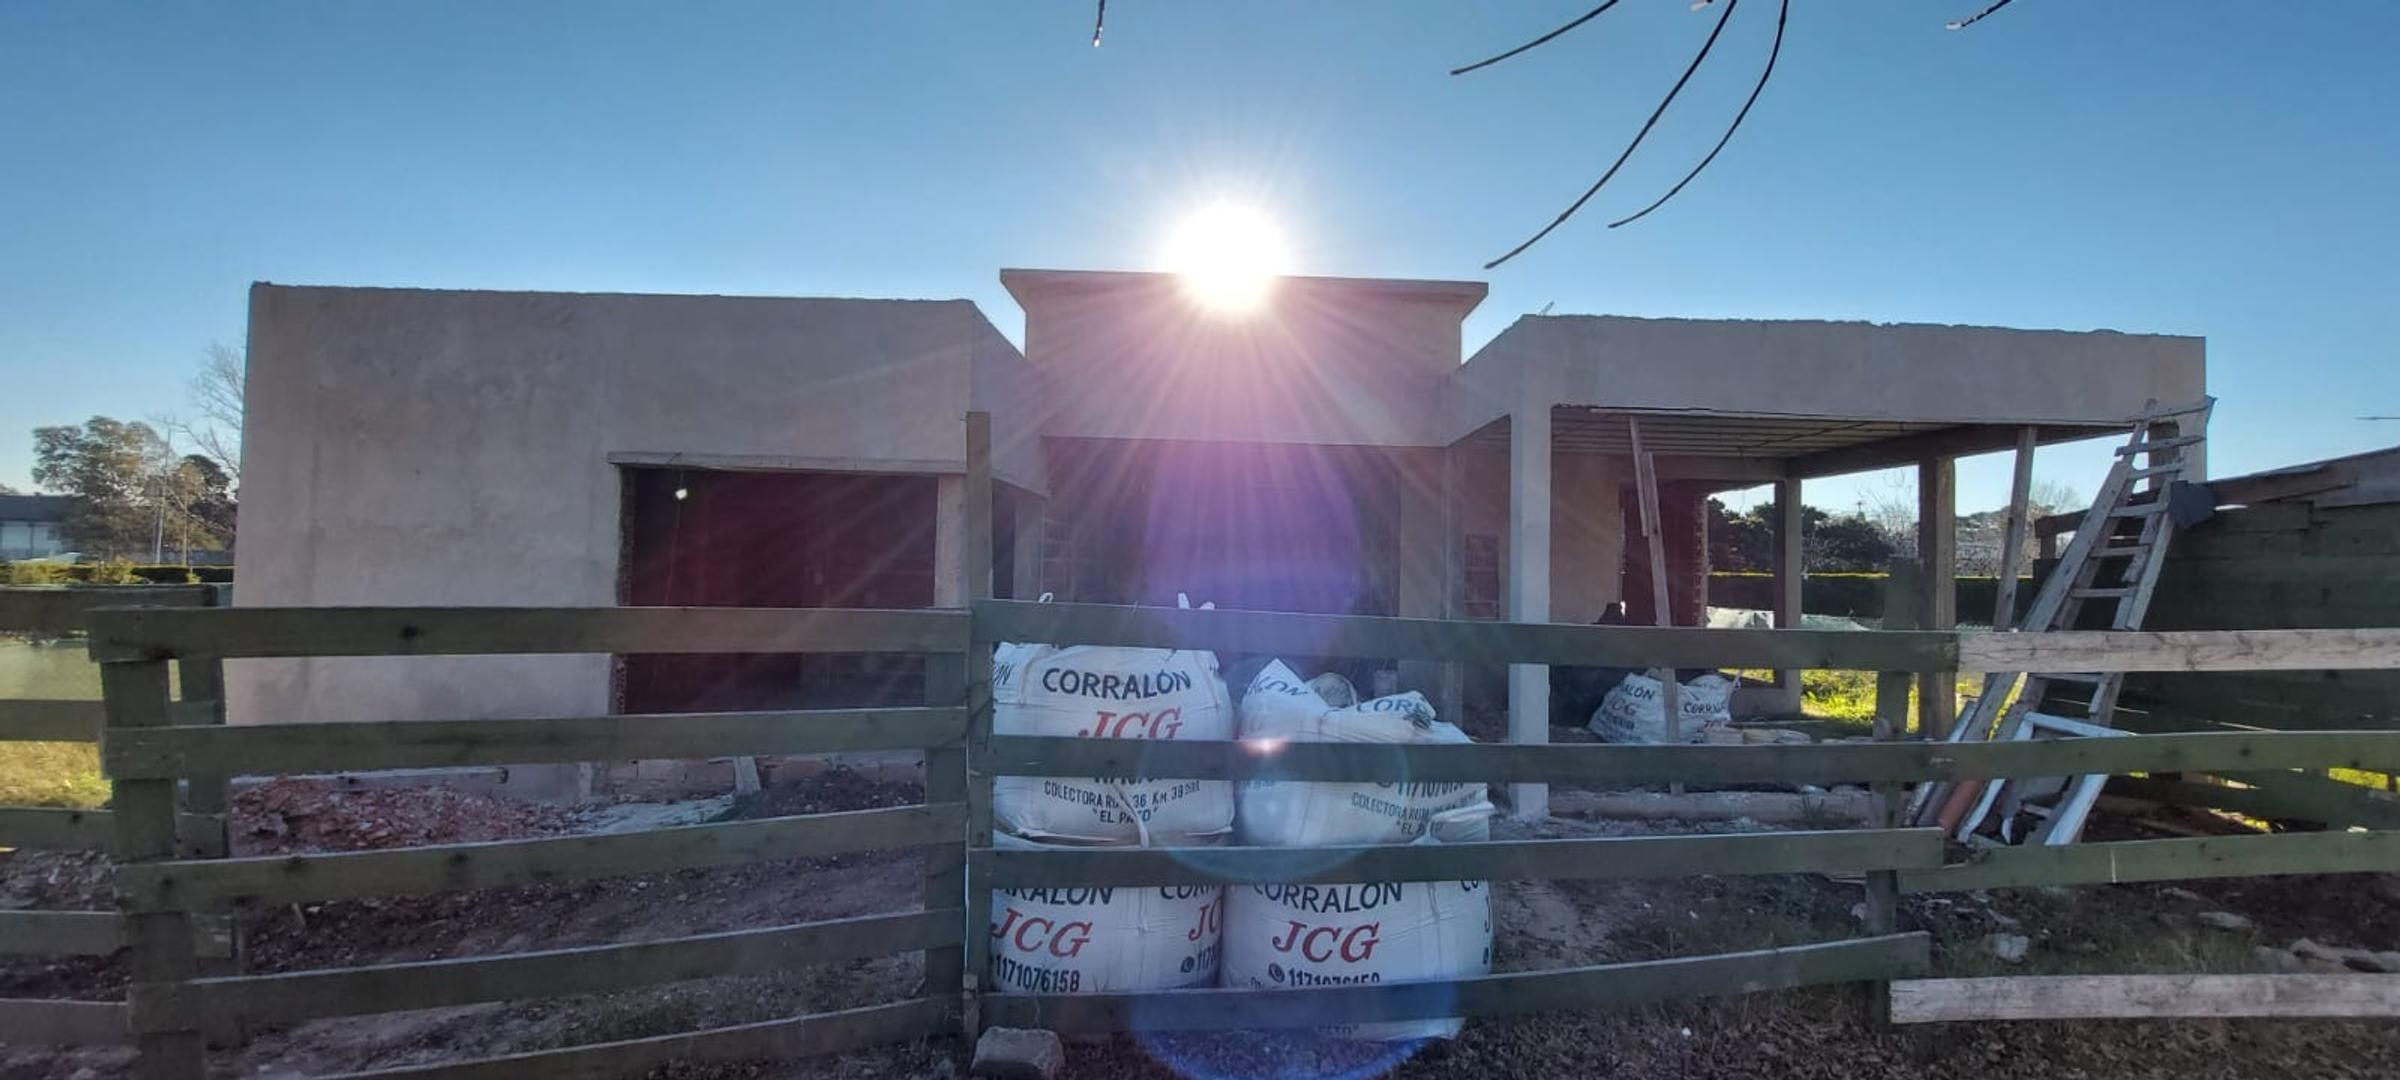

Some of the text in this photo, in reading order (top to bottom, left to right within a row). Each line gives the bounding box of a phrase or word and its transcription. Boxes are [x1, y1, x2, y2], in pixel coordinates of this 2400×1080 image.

[1042, 666, 1192, 701] CORRALÓN
[1078, 704, 1184, 740] JCG
[1044, 780, 1104, 808] COLECTORA
[990, 906, 1093, 958] JCG
[1271, 920, 1380, 963] JCG
[995, 954, 1080, 992] 1171076158
